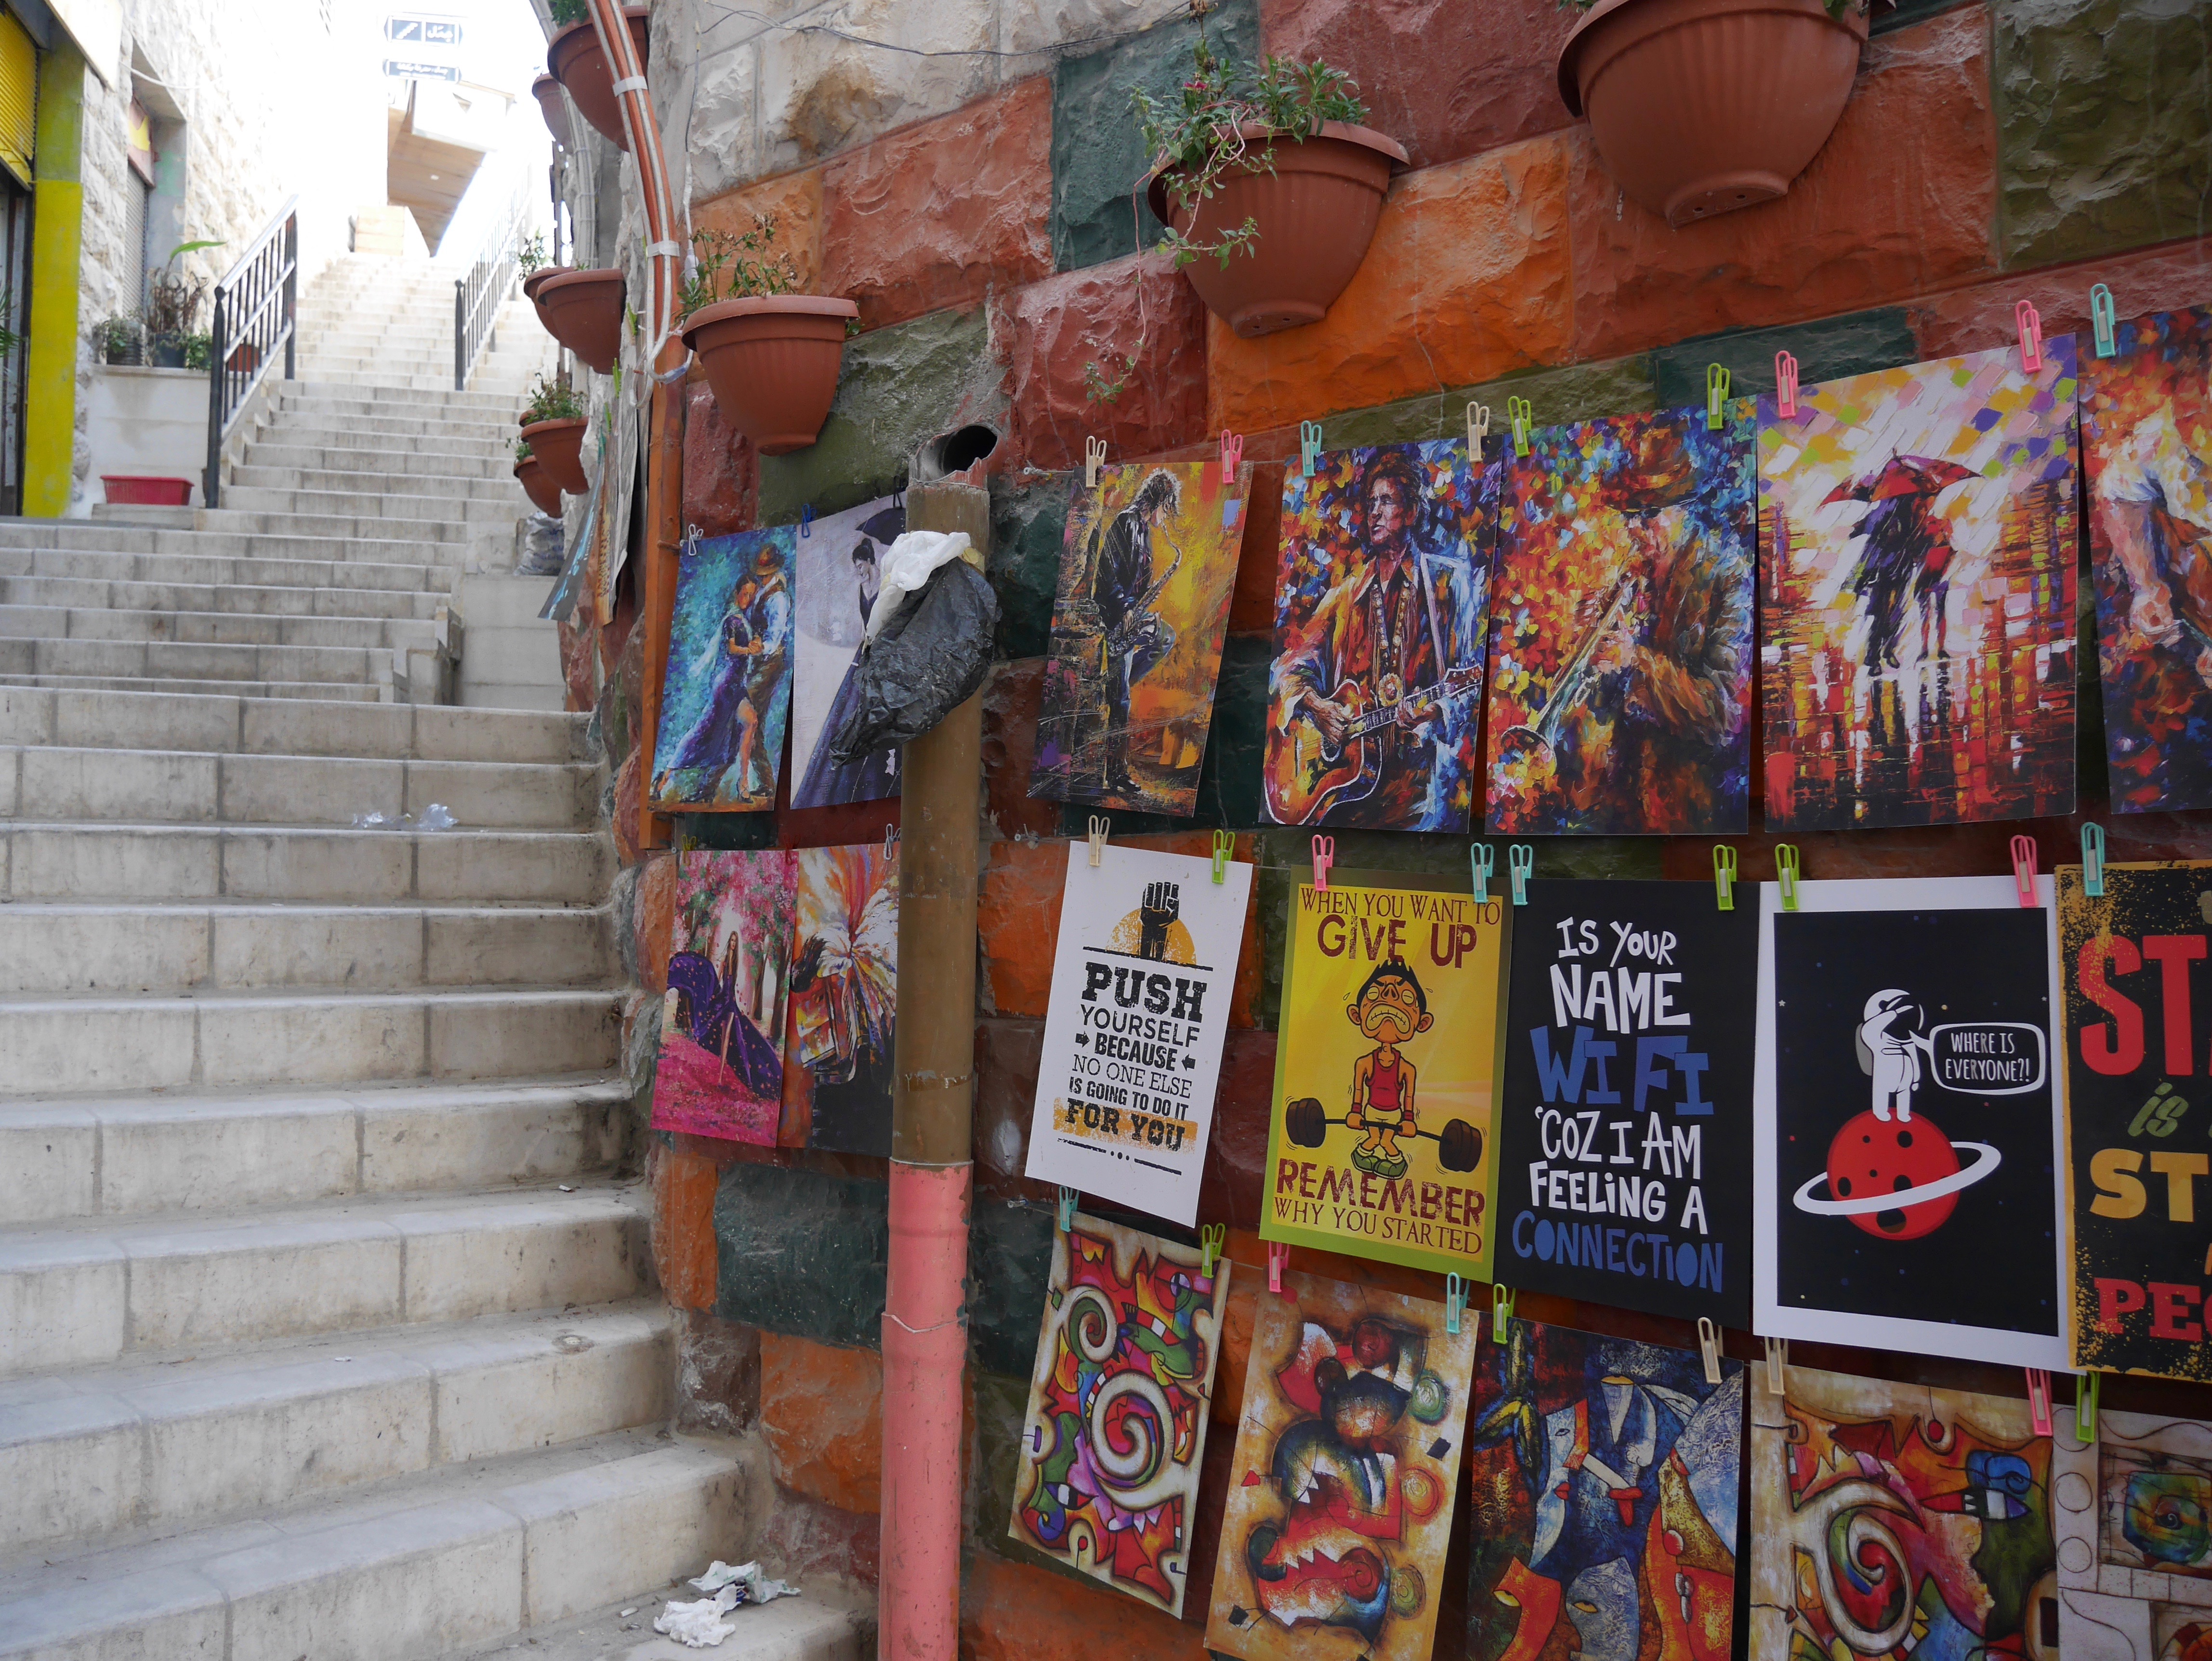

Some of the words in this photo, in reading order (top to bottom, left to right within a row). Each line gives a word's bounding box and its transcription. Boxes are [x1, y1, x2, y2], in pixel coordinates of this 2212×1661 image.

[1300, 887, 1357, 915] WHEN
[1363, 893, 1404, 918] YOU
[1409, 895, 1467, 923] WANT
[1473, 900, 1501, 925] TO
[1317, 914, 1406, 963] GIVE
[1430, 923, 1477, 968] UP
[1557, 916, 1599, 958] IS
[1609, 921, 1677, 967] YOUR
[1081, 962, 1207, 1023] PUSH
[1550, 963, 1691, 1034] NAME
[2078, 934, 2212, 1076] ST
[1080, 1004, 1200, 1048] YOURSELF
[1094, 1032, 1177, 1071] BECAUSE
[1951, 1032, 1995, 1055] WHERE
[2000, 1033, 2015, 1055] IS
[1072, 1054, 1101, 1076] NO
[1106, 1062, 1145, 1087] ONE
[1149, 1071, 1192, 1099] ELSE
[1529, 1025, 1621, 1104] WI
[1633, 1035, 1714, 1116] FI
[1945, 1058, 2030, 1082] EVERYONE?!
[1065, 1097, 1121, 1135] FOR
[1131, 1113, 1185, 1152] YOU
[1068, 1076, 1082, 1094] IS
[1086, 1081, 1128, 1106] GOING
[1132, 1091, 1149, 1111] TO
[1152, 1097, 1171, 1117] DO
[1175, 1103, 1188, 1121] IT
[1609, 1121, 1634, 1164] I
[1641, 1111, 1701, 1179] AM
[1276, 1158, 1485, 1227] REMEMBER
[1680, 1186, 1708, 1235] A
[1274, 1197, 1325, 1226] WHY
[1332, 1207, 1377, 1235] YOU
[1382, 1216, 1482, 1255] STARTED
[1512, 1210, 1724, 1293] CONNECTION
[2094, 1277, 2212, 1342] PE
